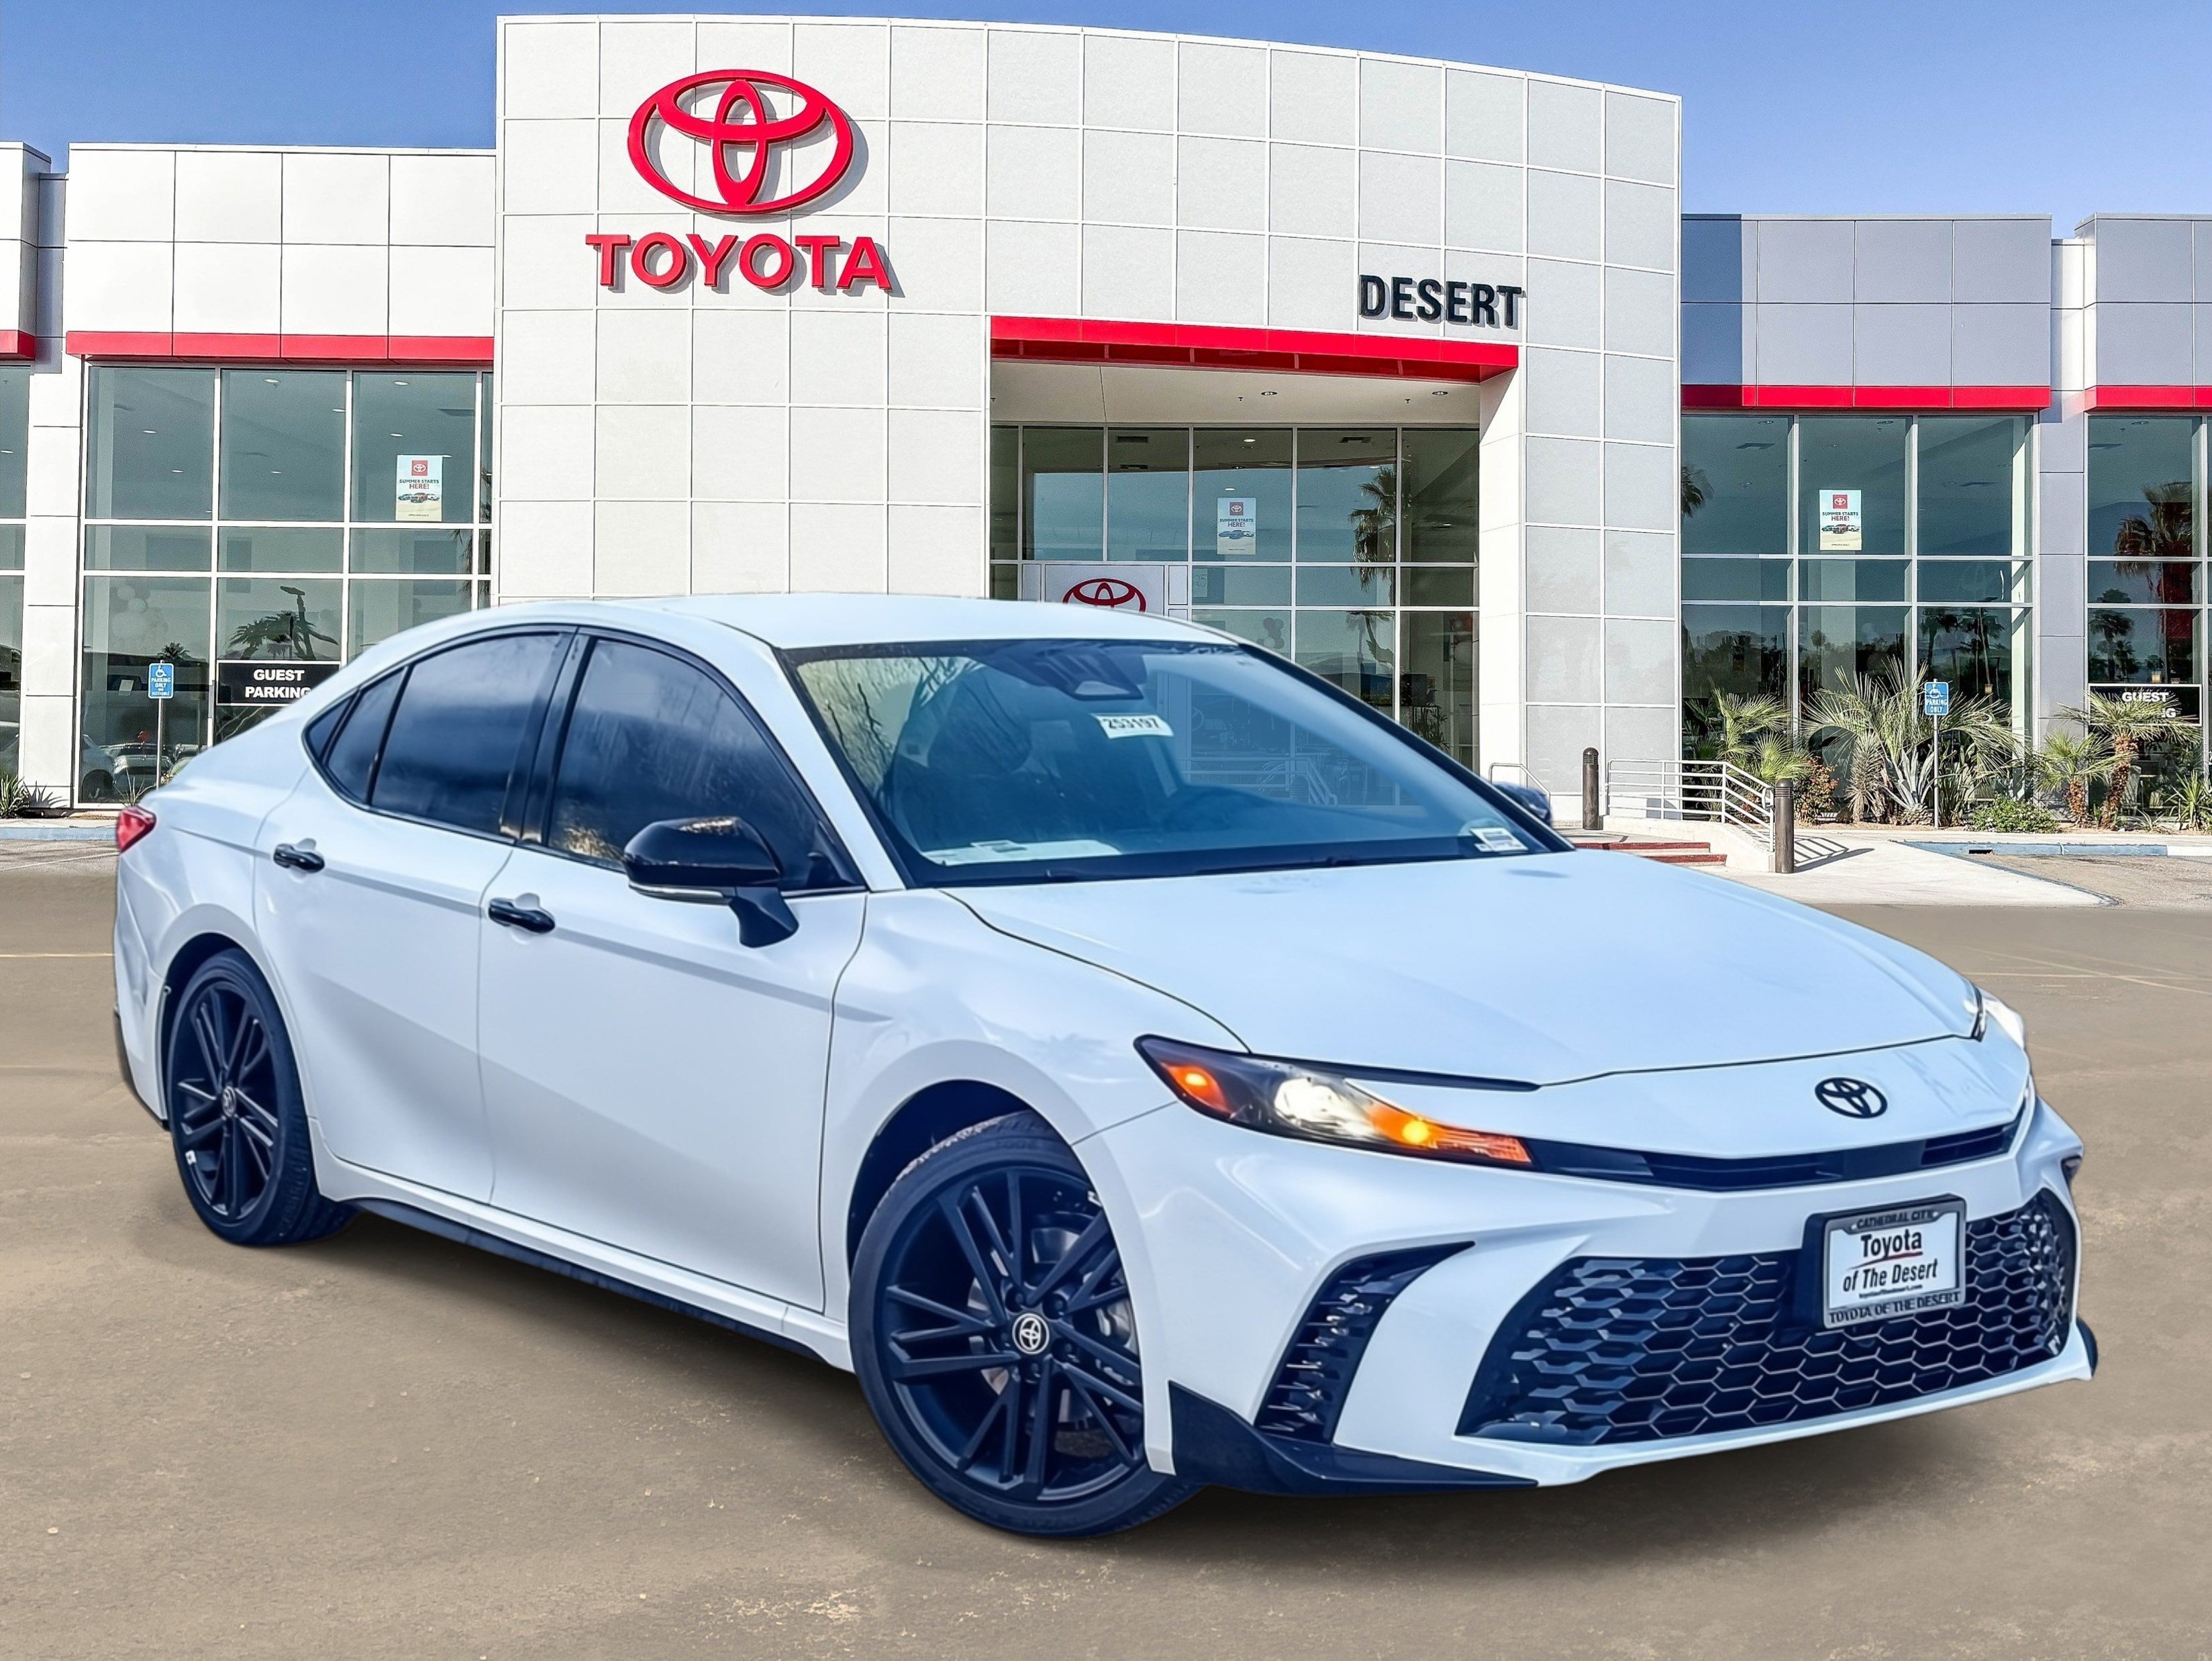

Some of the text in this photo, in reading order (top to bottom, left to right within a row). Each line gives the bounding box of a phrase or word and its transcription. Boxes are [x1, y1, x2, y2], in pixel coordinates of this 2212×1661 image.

[586, 232, 892, 290] TOYOTA
[1359, 274, 1521, 326] DESERT
[253, 669, 305, 681] GUEST
[1925, 698, 1948, 706] PARKING
[2121, 691, 2169, 703] GUEST
[1930, 705, 1944, 713] ONLY
[1857, 1211, 1910, 1229] CATHEDRAL
[1860, 1229, 1922, 1258] Toyota
[1843, 1270, 1859, 1292] of
[1862, 1268, 1888, 1289] The
[1891, 1258, 1938, 1284] Desert
[1829, 1309, 1872, 1324] TOYOTA
[1875, 1305, 1889, 1316] OF
[1894, 1299, 1915, 1313] THE
[1917, 1291, 1961, 1309] DESERT
